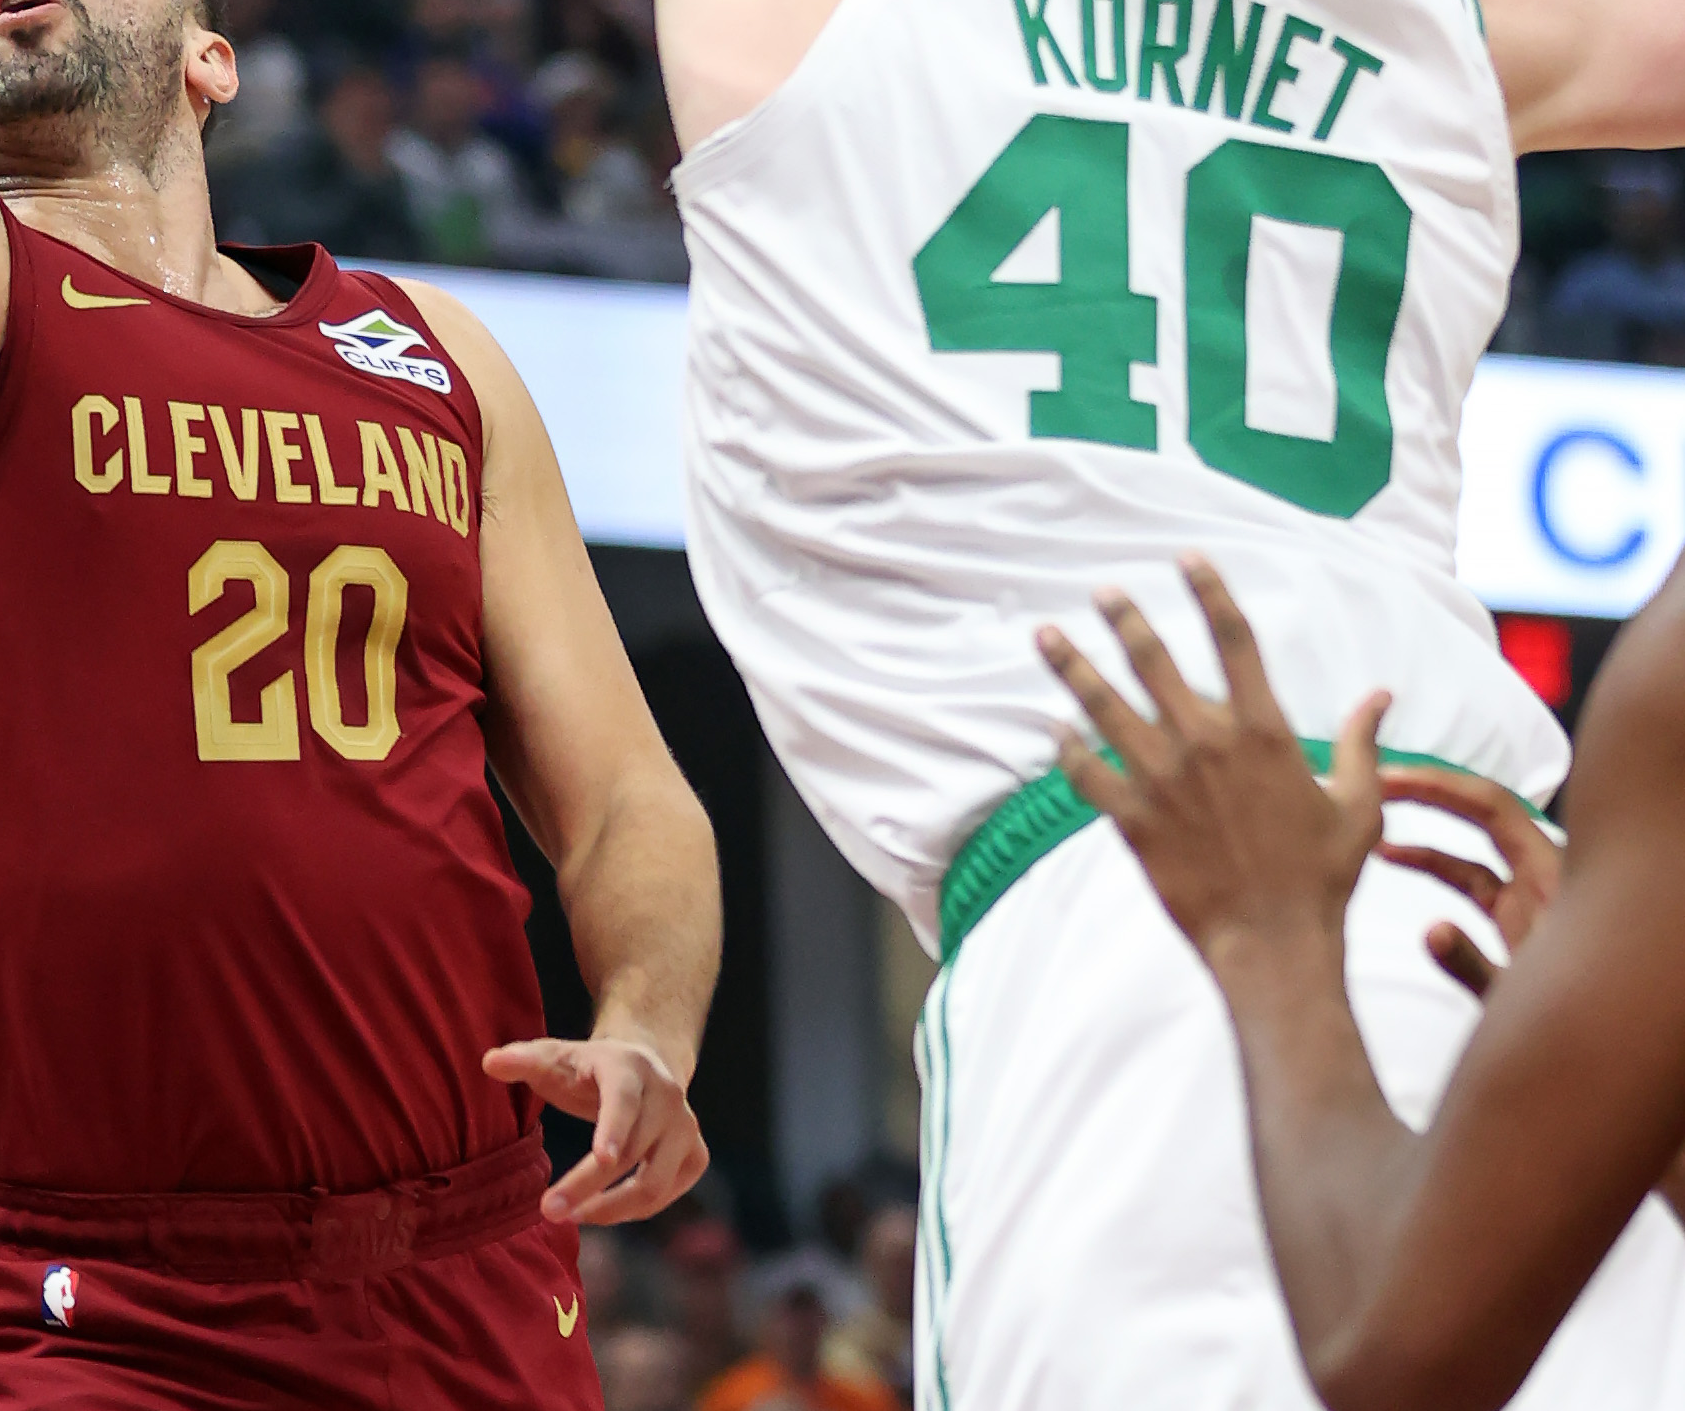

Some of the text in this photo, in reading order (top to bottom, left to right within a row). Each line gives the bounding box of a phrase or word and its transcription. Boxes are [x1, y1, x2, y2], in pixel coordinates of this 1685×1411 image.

[341, 350, 447, 387] CLIFFS
[912, 113, 1412, 519] 40
[70, 394, 470, 539] CLEVELAND
[1529, 427, 1649, 568] C
[187, 540, 408, 762] 20
